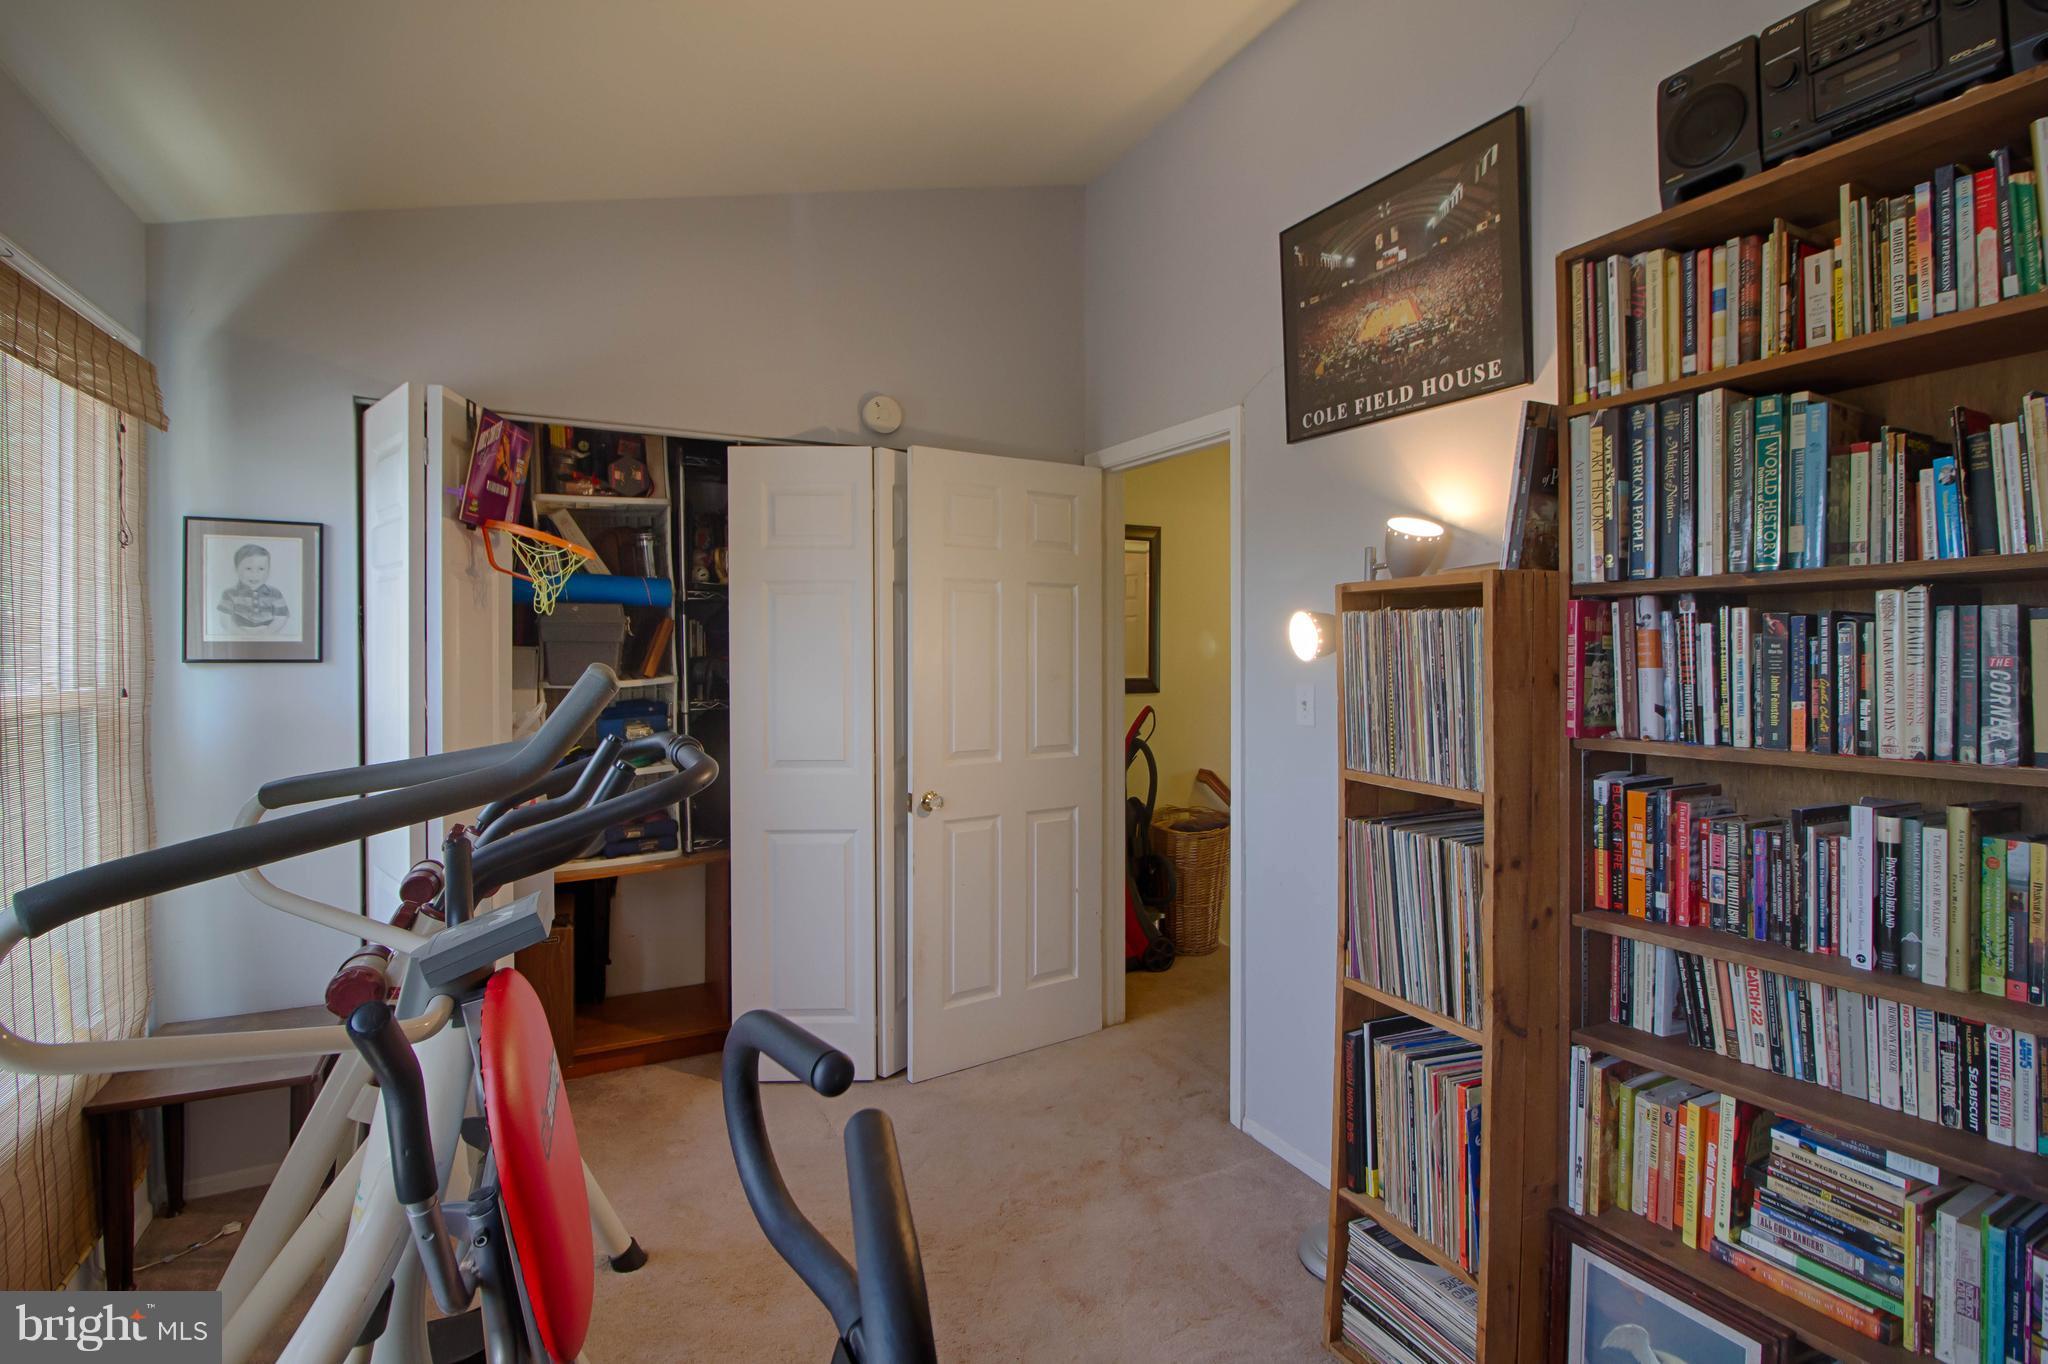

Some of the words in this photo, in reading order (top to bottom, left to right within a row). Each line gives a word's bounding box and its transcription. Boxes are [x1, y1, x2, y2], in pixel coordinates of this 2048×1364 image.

[1769, 16, 1800, 36] SONY
[1942, 187, 1951, 205] THE
[1942, 208, 1951, 237] GREAT
[2000, 200, 2008, 228] WORLD
[2004, 245, 2011, 253] II
[1893, 228, 1904, 264] MURDER
[1686, 257, 1695, 269] THE
[1921, 257, 1929, 279] BABE
[1942, 239, 1951, 291] DEPRESSION
[1686, 271, 1695, 306] FOUNDING
[1893, 275, 1904, 314] CENTURY
[1921, 281, 1929, 302] RUTH
[1686, 307, 1695, 316] OF
[1686, 318, 1695, 347] AMERICA
[1302, 402, 1348, 429] COLE
[1354, 385, 1414, 416] FIELD
[1421, 359, 1503, 398] HOUSE
[1733, 410, 1741, 445] UNITED
[1592, 450, 1604, 473] ART
[1605, 434, 1613, 475] WILD
[1632, 438, 1643, 497] AMERICAN
[1665, 438, 1678, 480] Making
[1733, 447, 1741, 477] STATES
[1764, 441, 1777, 495] WORLD
[1575, 460, 1585, 481] ART
[1733, 479, 1741, 487] in
[1757, 466, 1765, 493] Patterns
[1575, 484, 1585, 497] IN
[1605, 476, 1613, 520] WEST
[1665, 484, 1678, 519] Nation
[1592, 479, 1604, 533] HISTORY
[1733, 489, 1741, 523] Literature
[1575, 499, 1585, 551] HISTORY
[1632, 505, 1643, 553] PEOPLE
[1764, 499, 1777, 559] HISTORY
[1794, 635, 1799, 643] IN
[1883, 629, 1896, 655] LAKE
[1799, 656, 1804, 665] OF
[1939, 656, 1948, 675] JACK
[1990, 657, 2009, 667] THE
[1770, 675, 1780, 691] John
[1820, 678, 1830, 704] Agatha
[1883, 657, 1896, 704] WOBEGON
[1906, 672, 1915, 695] NEVER
[1770, 693, 1780, 726] Feinstein
[1906, 697, 1915, 727] RESTS
[1939, 686, 1948, 714] RIPPER
[1989, 669, 2011, 740] CORNER
[1820, 705, 1830, 732] Christie
[1883, 707, 1896, 730] DAYS
[1613, 785, 1622, 829] BLACK
[1728, 826, 1739, 858] INVISIBLE
[1932, 834, 1941, 847] The
[1613, 842, 1622, 870] FIRE
[1728, 859, 1739, 875] MAN
[1932, 848, 1941, 876] GRAVES
[1728, 875, 1739, 898] RALPH
[1885, 857, 1897, 896] PINT-SIZED
[1932, 878, 1941, 894] ARE
[1728, 898, 1739, 924] ELLISON
[1885, 897, 1897, 928] IRELAND
[1932, 895, 1941, 937] WALKING
[1746, 968, 1764, 1025] CATCH-22
[1888, 1006, 1897, 1043] ROBINSON
[1917, 1008, 1933, 1033] ALIVE
[1346, 1040, 1354, 1085] THROUGH
[1888, 1044, 1897, 1073] CRUSOE
[1990, 1043, 1999, 1060] THE
[2000, 1045, 2011, 1082] MICHAEL
[1941, 1050, 1956, 1086] JURASSIC
[1990, 1069, 1999, 1088] LOST
[1346, 1086, 1354, 1120] INDIAN
[1941, 1085, 1956, 1107] PARK
[1969, 1066, 1979, 1131] SEABISCUIT
[1990, 1095, 1999, 1124] WORLD
[2000, 1085, 2011, 1129] CRICHTON
[1651, 1106, 1659, 1127] THINGS
[1724, 1102, 1732, 1121] Love,
[1346, 1121, 1354, 1144] EYES
[1651, 1127, 1659, 1144] FALL
[1687, 1129, 1695, 1153] MORE
[1724, 1125, 1732, 1150] Africa
[1651, 1144, 1659, 1163] APART
[1687, 1155, 1695, 1181] THAN
[1707, 1142, 1717, 1165] Conflict
[1706, 1165, 1715, 1180] and
[1790, 1152, 1813, 1168] THREE
[1814, 1161, 1838, 1176] NEGRO
[1839, 1171, 1874, 1191] CLASSICS
[1687, 1183, 1695, 1223] CHATTEL
[1704, 1180, 1714, 1218] Compromise
[1759, 1216, 1773, 1230] ALL
[1774, 1222, 1791, 1238] GOD'S
[1793, 1230, 1824, 1253] DANGERS
[1762, 1271, 1779, 1283] The
[1780, 1279, 1821, 1305] Invention
[1836, 1306, 1864, 1327] Wings
